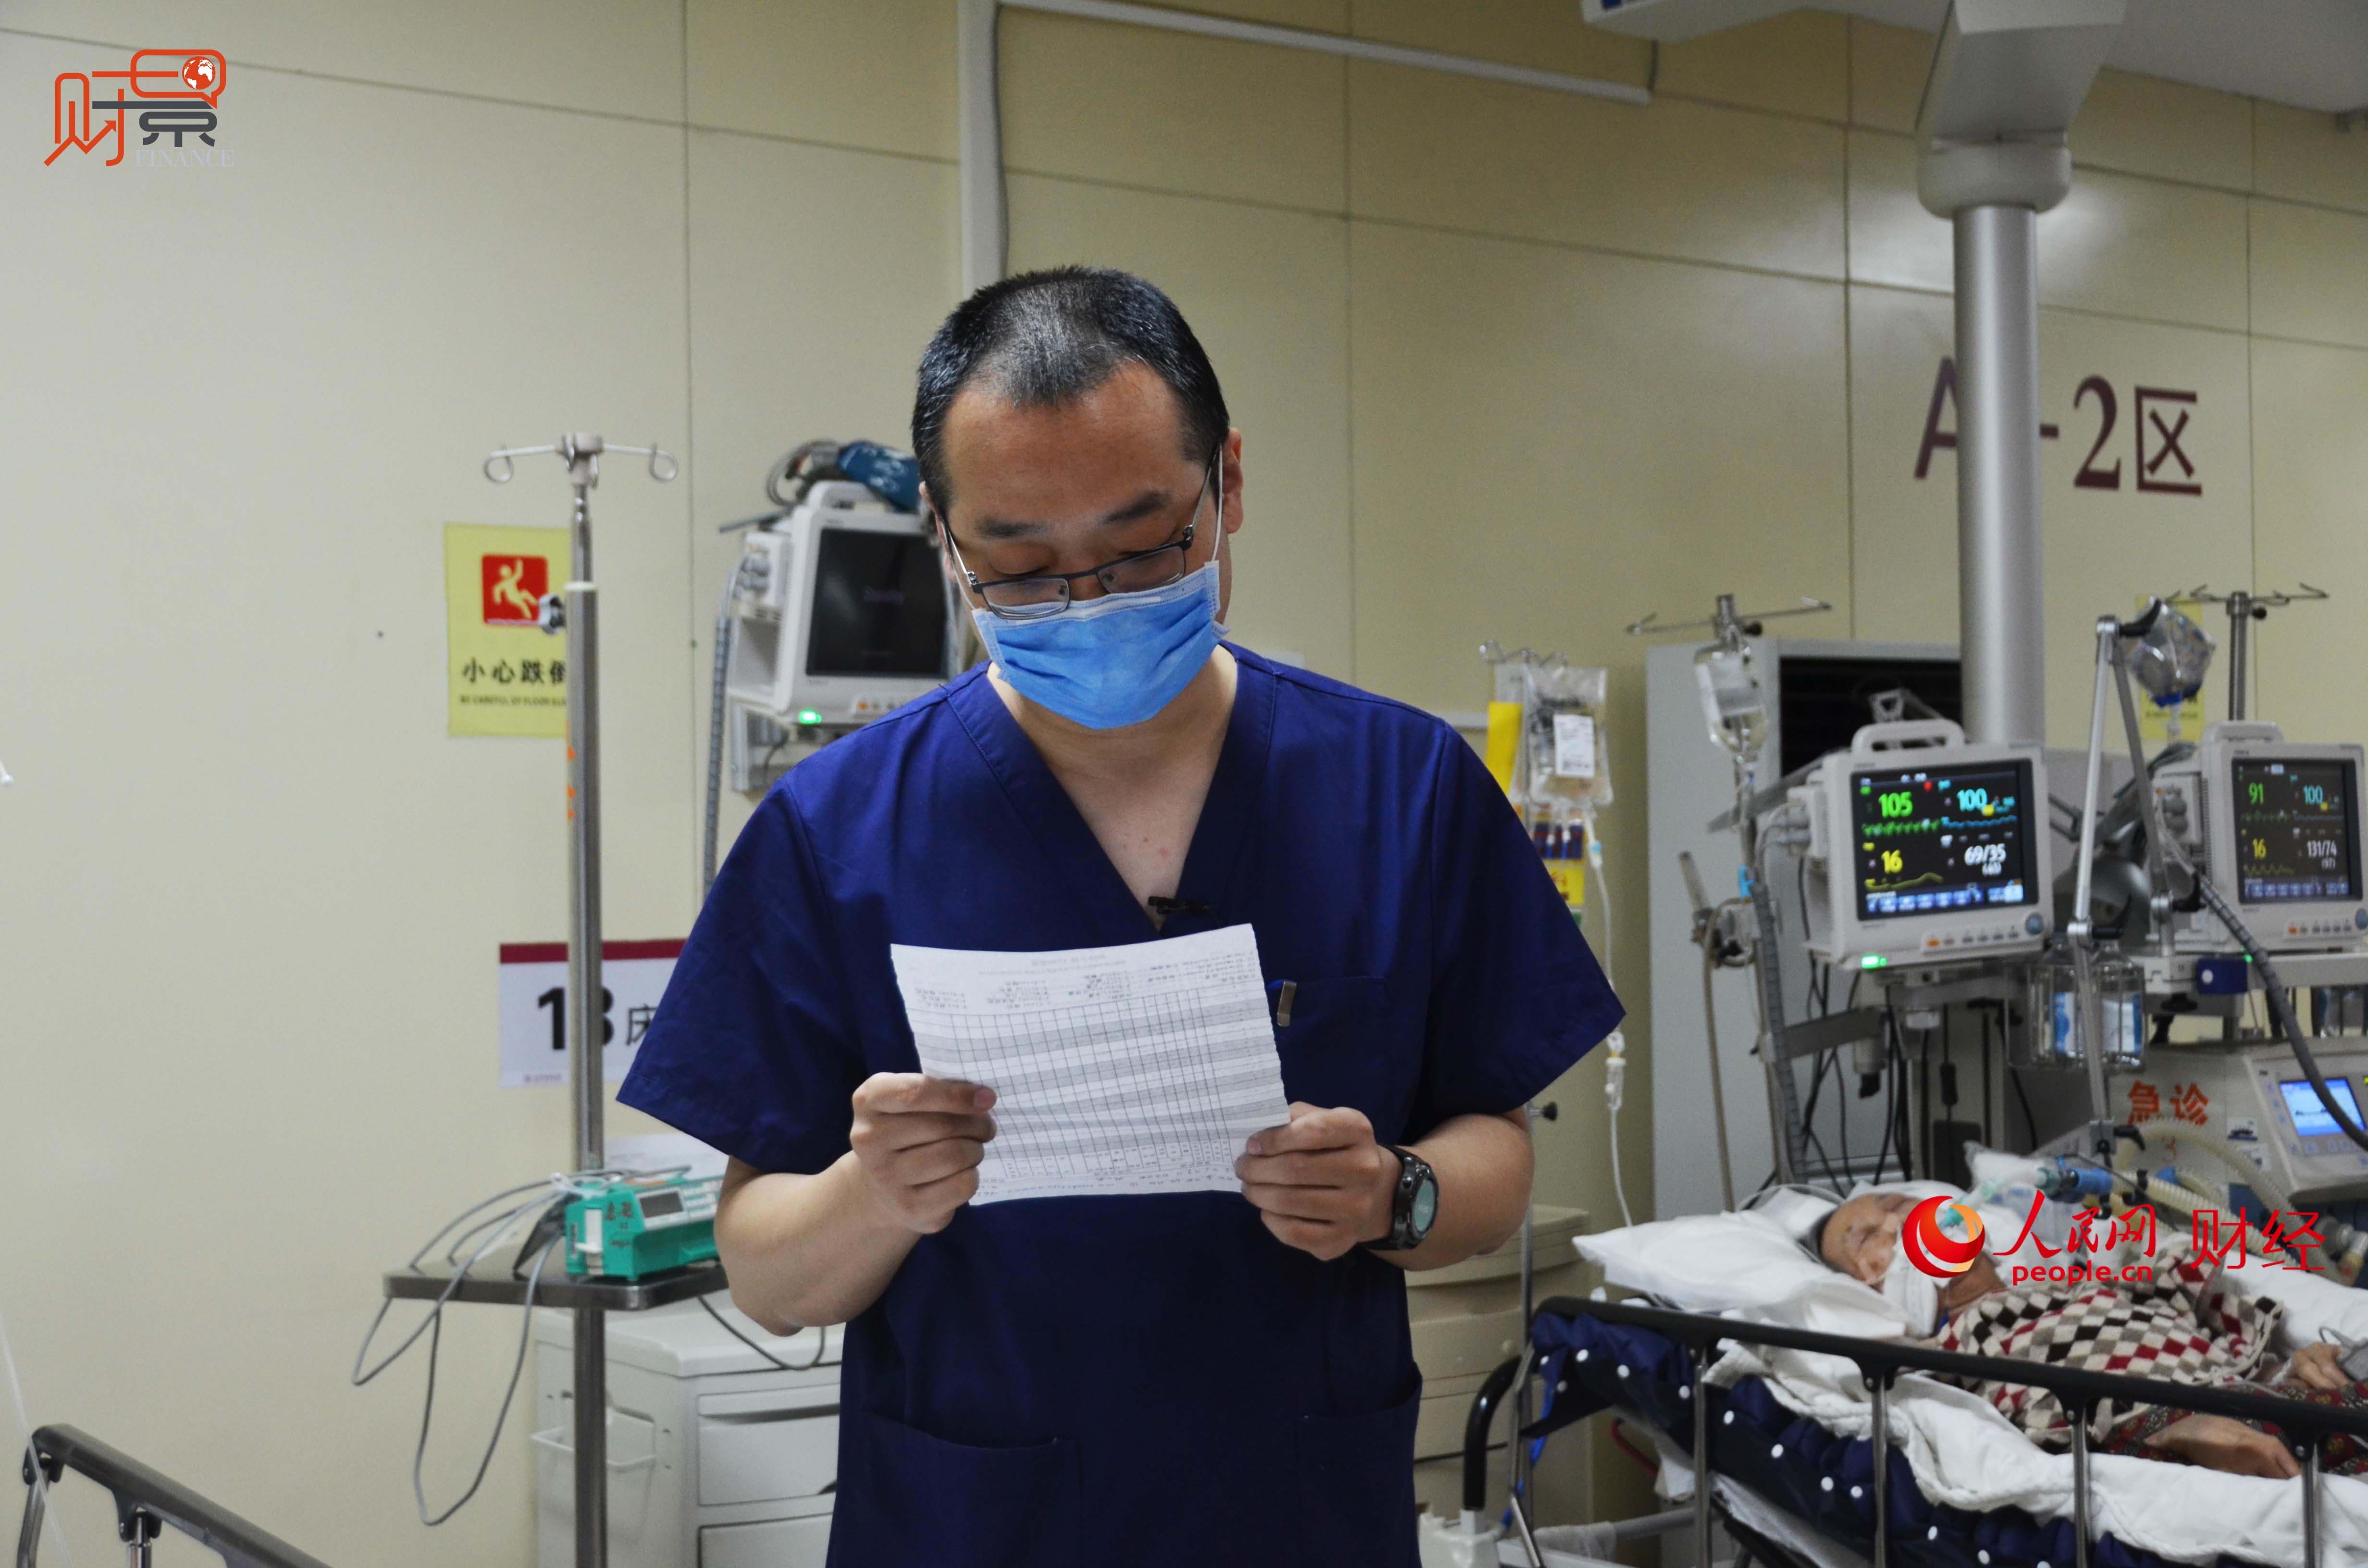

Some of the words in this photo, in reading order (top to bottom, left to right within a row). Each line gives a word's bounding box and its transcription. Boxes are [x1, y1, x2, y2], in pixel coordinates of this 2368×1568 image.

[1879, 792, 1913, 818] 105
[1957, 788, 1988, 812] 100
[2249, 782, 2264, 805] 91
[2304, 784, 2323, 805] 100
[1881, 849, 1903, 874] 16
[1964, 843, 2006, 866] 69/35
[2252, 838, 2267, 859] 16
[2127, 1079, 2210, 1127] 急诊
